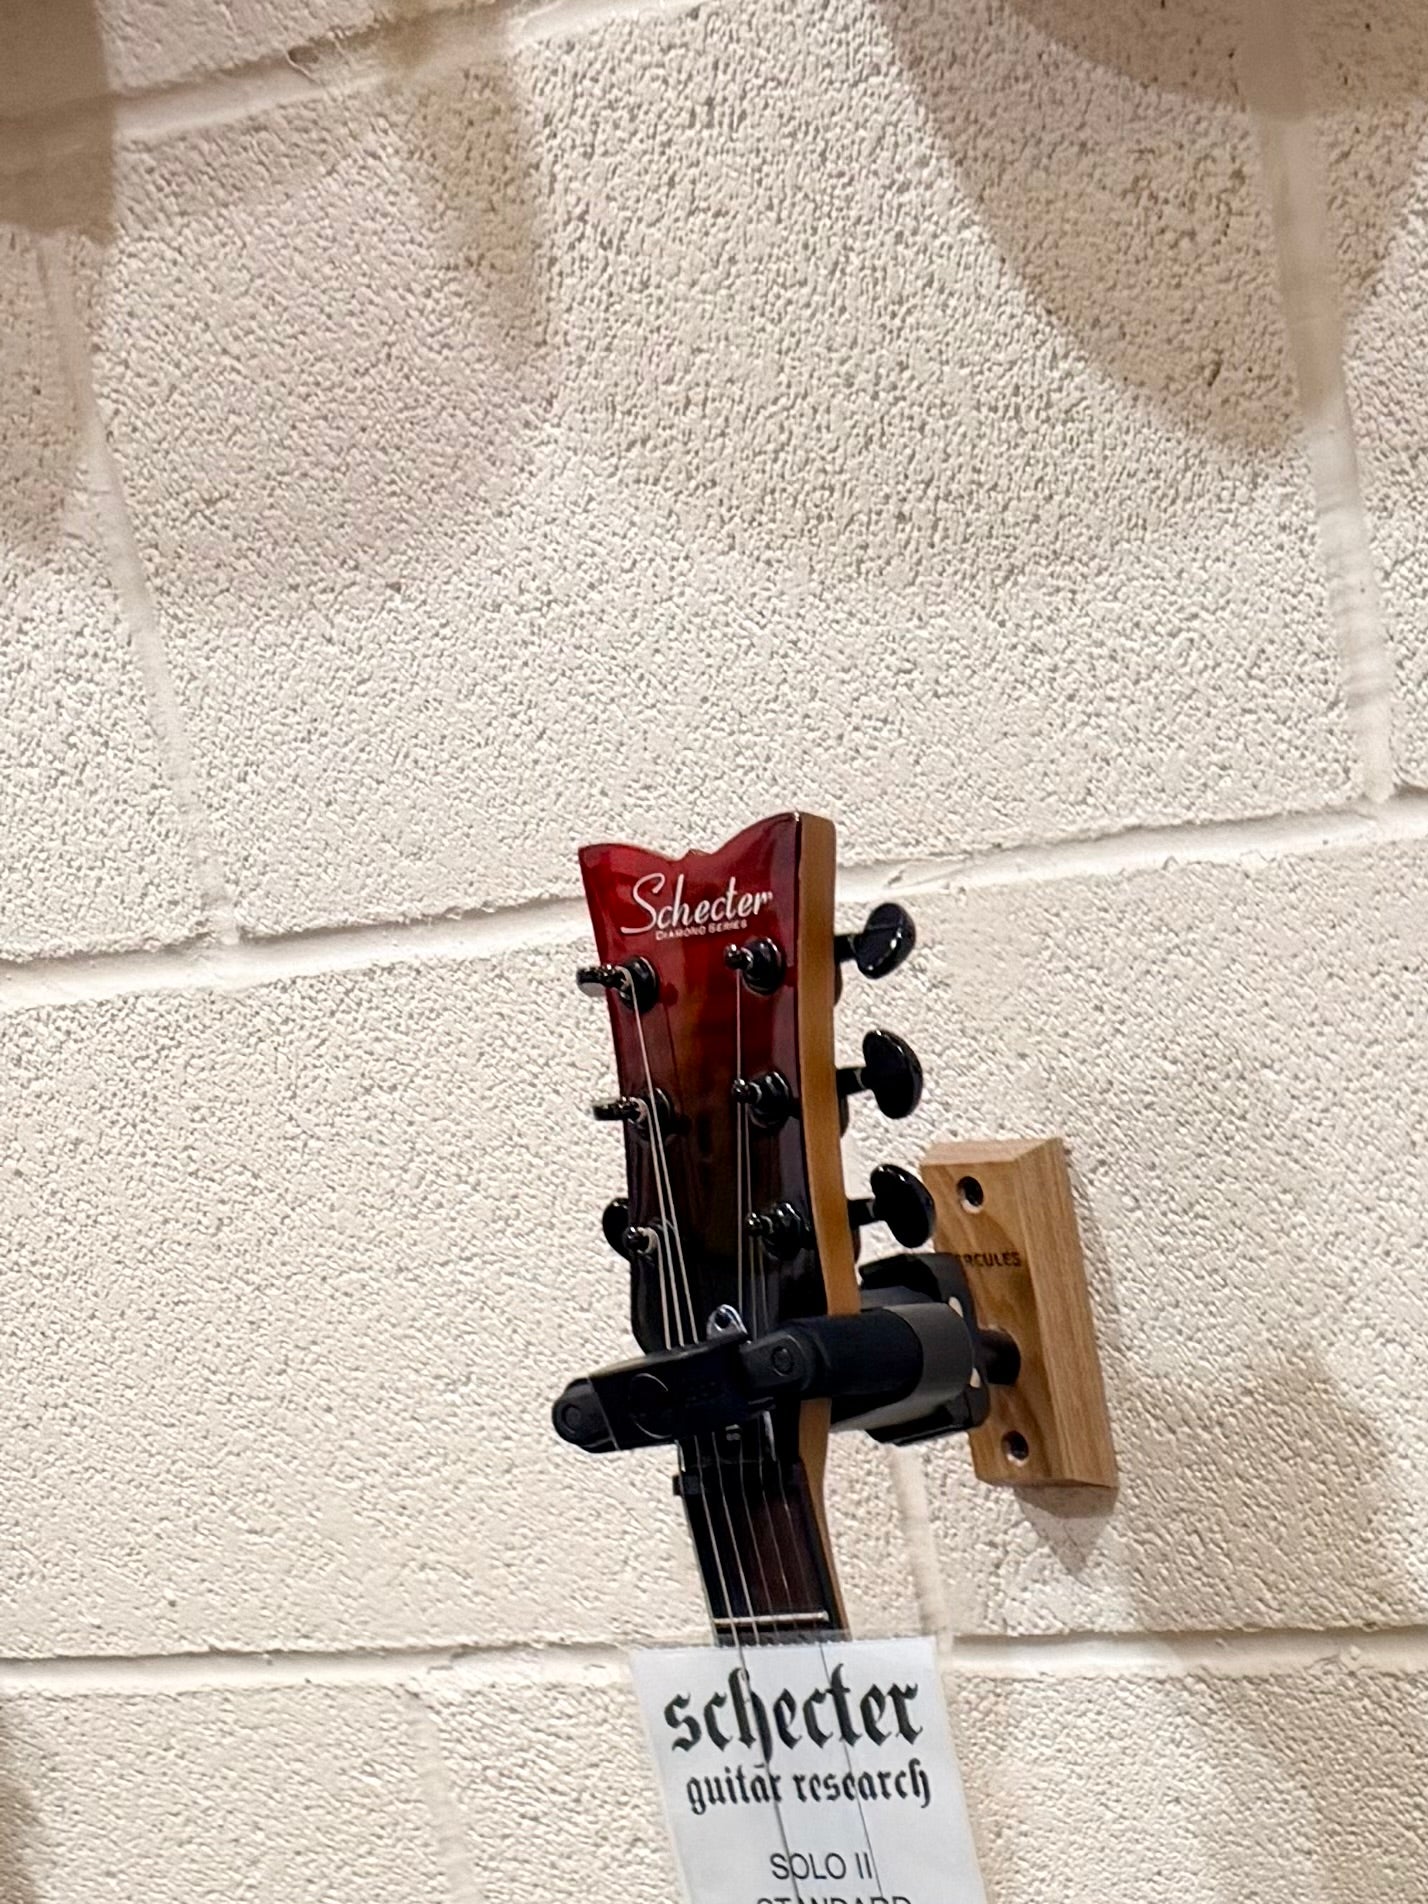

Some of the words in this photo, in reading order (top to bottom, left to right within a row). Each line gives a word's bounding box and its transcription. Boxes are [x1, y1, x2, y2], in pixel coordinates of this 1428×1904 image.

[620, 872, 773, 934] Schecter
[655, 925, 706, 941] DIAMOND
[708, 918, 748, 934] SERIES
[663, 1662, 924, 1765] schecter
[686, 1763, 782, 1816] guitar
[792, 1758, 932, 1809] research
[769, 1852, 847, 1881] SOLO
[857, 1852, 873, 1879] II
